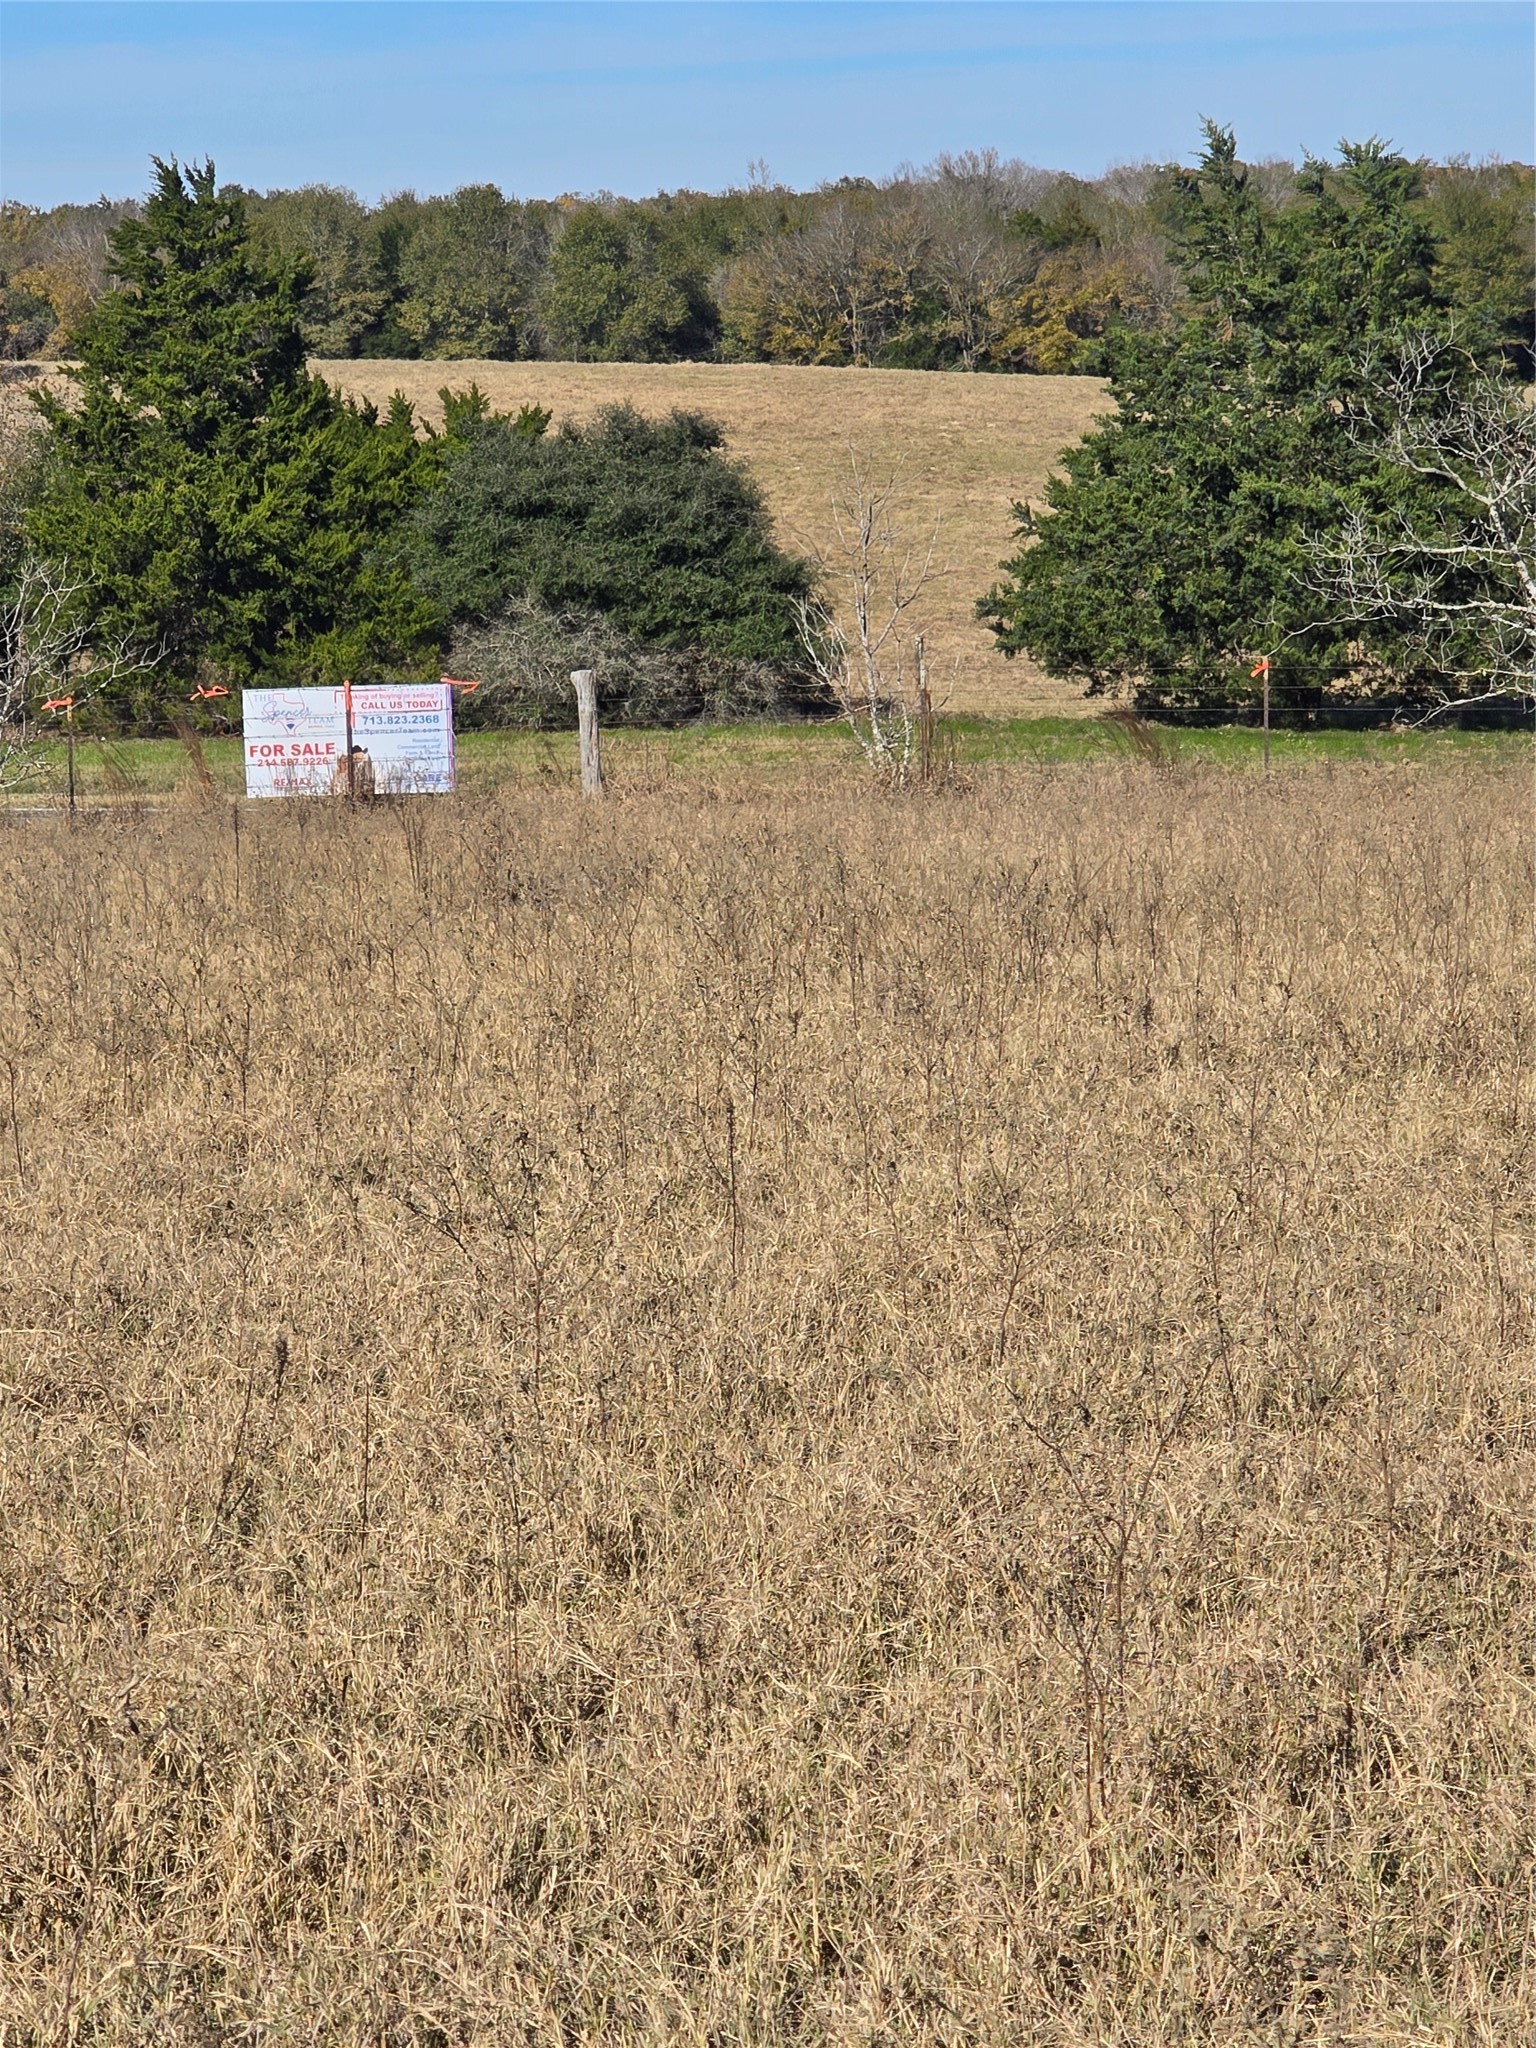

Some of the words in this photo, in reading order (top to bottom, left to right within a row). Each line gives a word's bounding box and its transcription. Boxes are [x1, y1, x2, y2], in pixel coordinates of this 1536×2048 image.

[253, 694, 273, 702] THE
[379, 692, 401, 700] buying
[412, 691, 439, 699] selling?
[389, 701, 403, 709] US
[307, 716, 335, 724] TEAM
[362, 714, 440, 725] 713.823.2368
[249, 744, 285, 758] FOR
[291, 742, 336, 755] SALE
